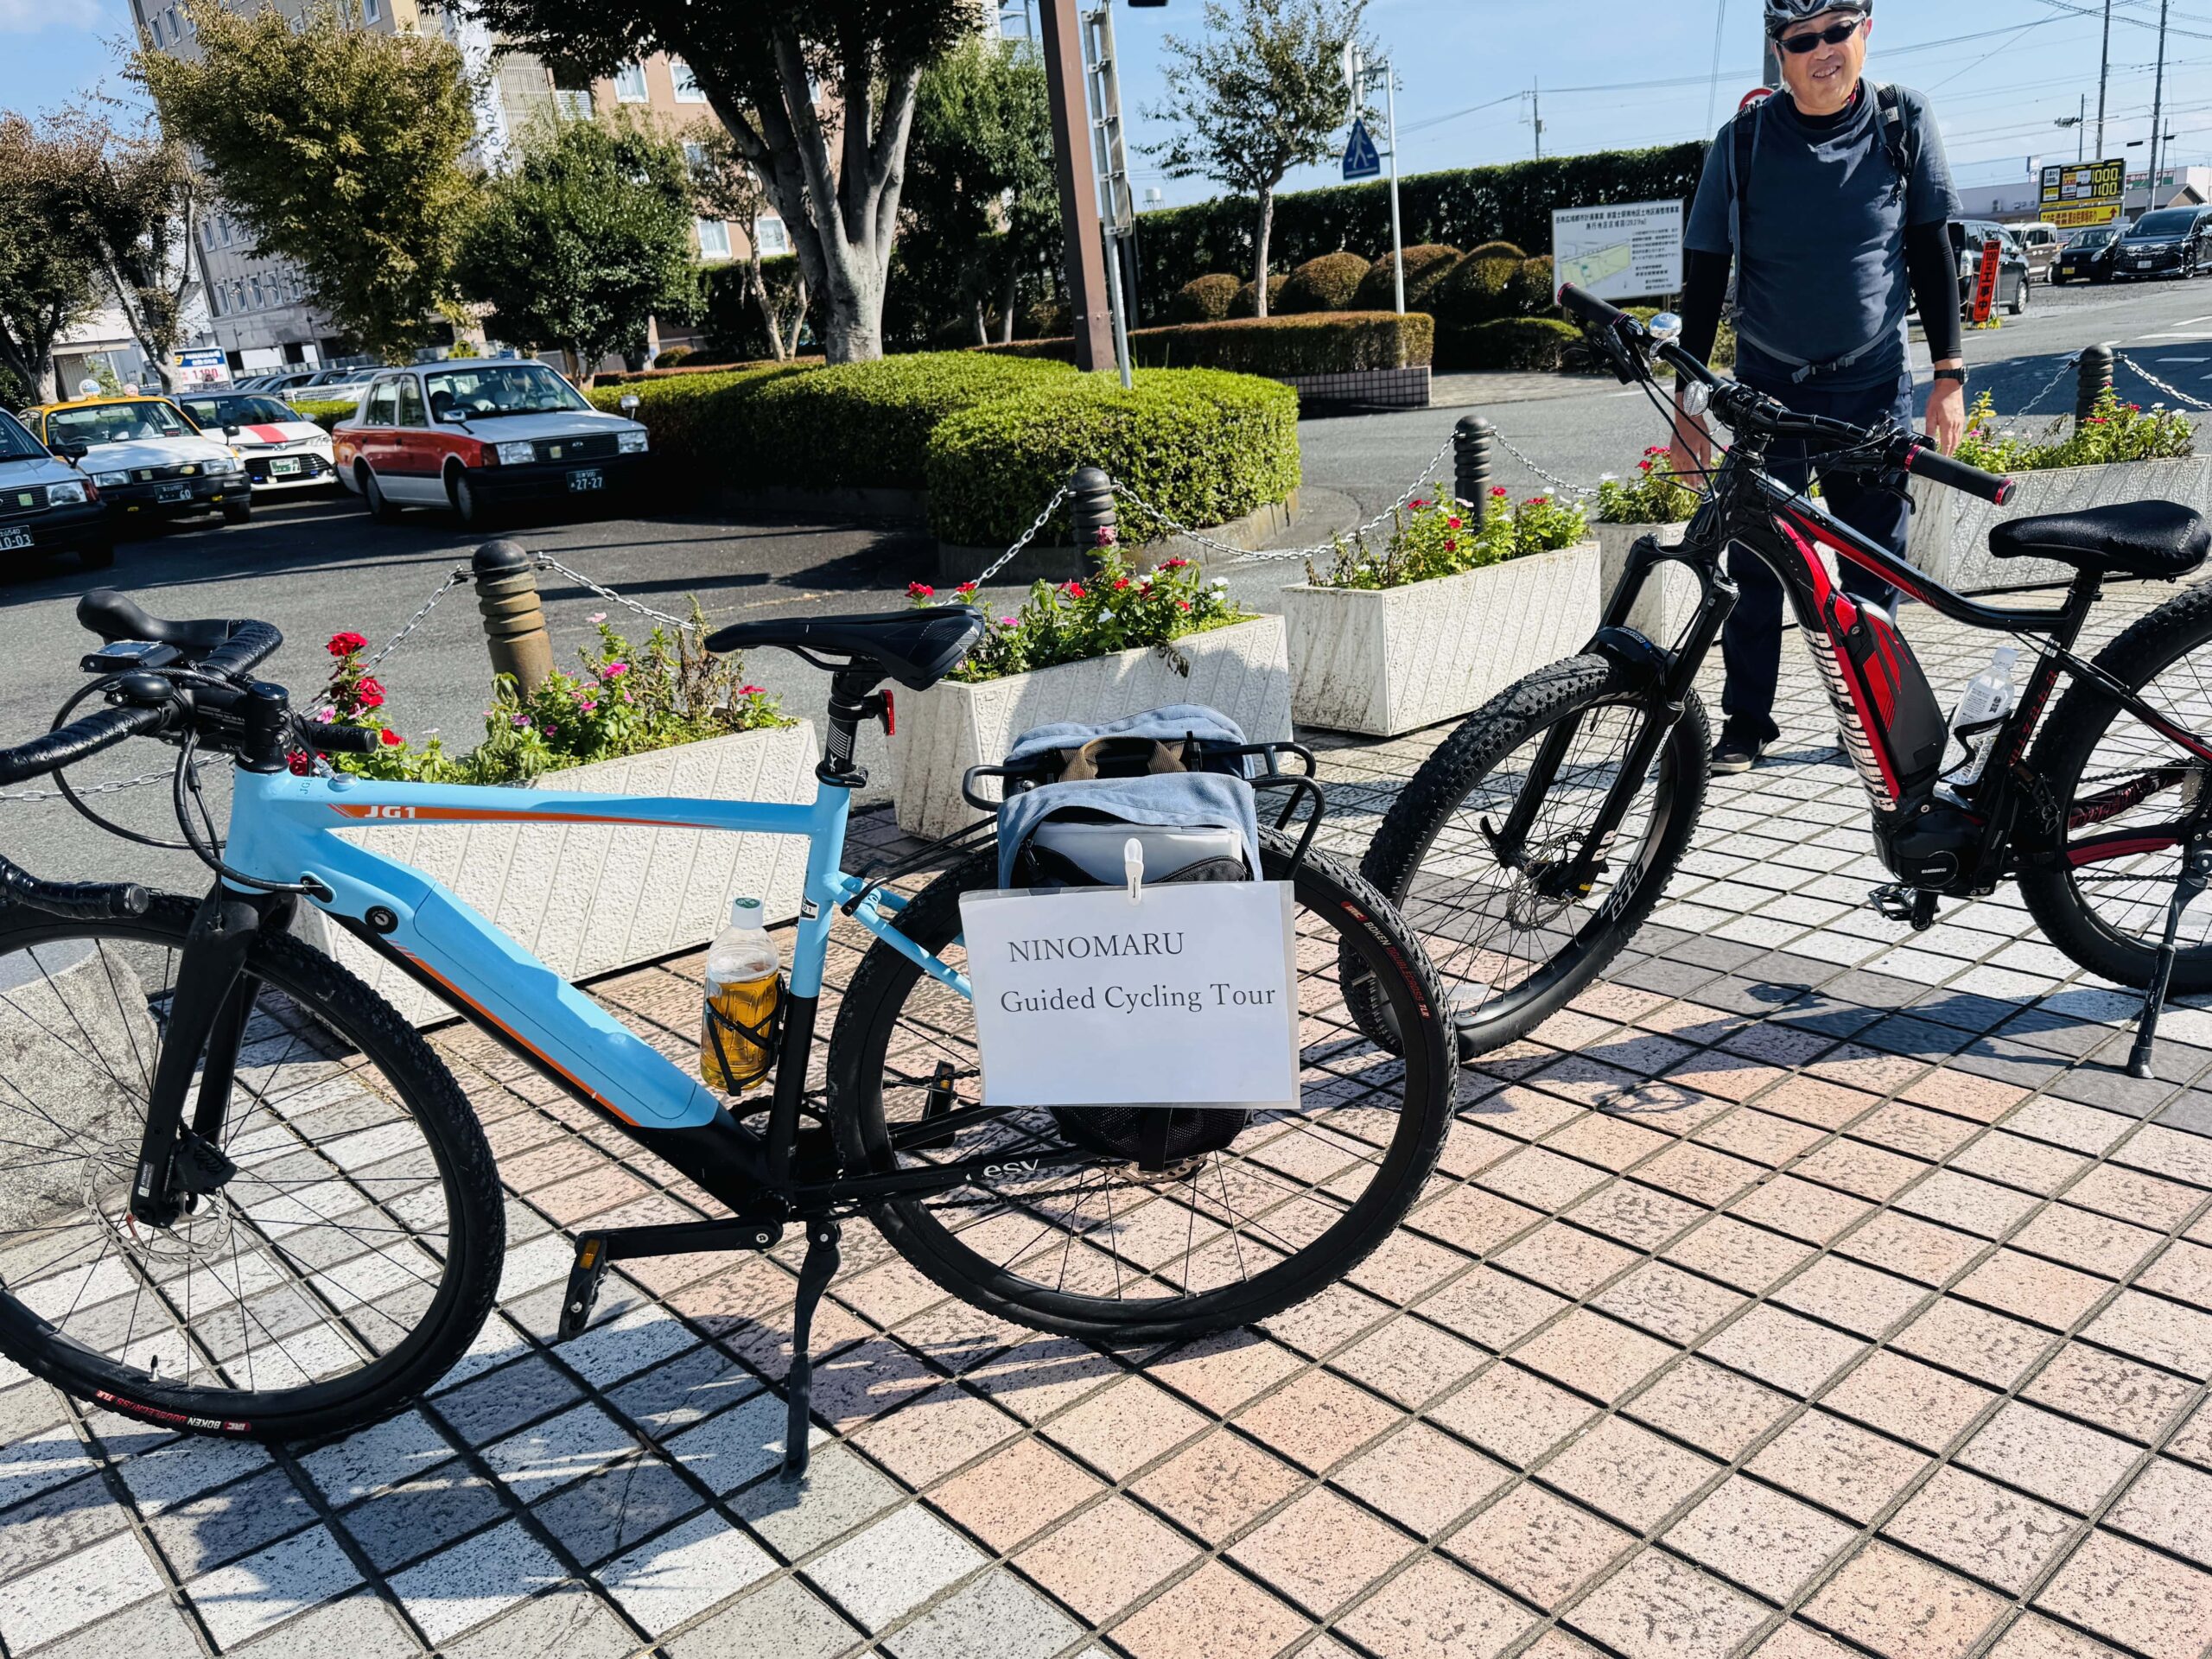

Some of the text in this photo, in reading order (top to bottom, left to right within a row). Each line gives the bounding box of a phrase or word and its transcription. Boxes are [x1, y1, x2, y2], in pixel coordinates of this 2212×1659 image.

[575, 476, 602, 491] 27-27
[364, 805, 416, 819] JG1
[1363, 921, 1391, 946] BOKEN
[1007, 931, 1185, 963] NINOMARU
[1000, 982, 1276, 1014] Guided Cycling Tour
[187, 1416, 221, 1430] BOKEN
